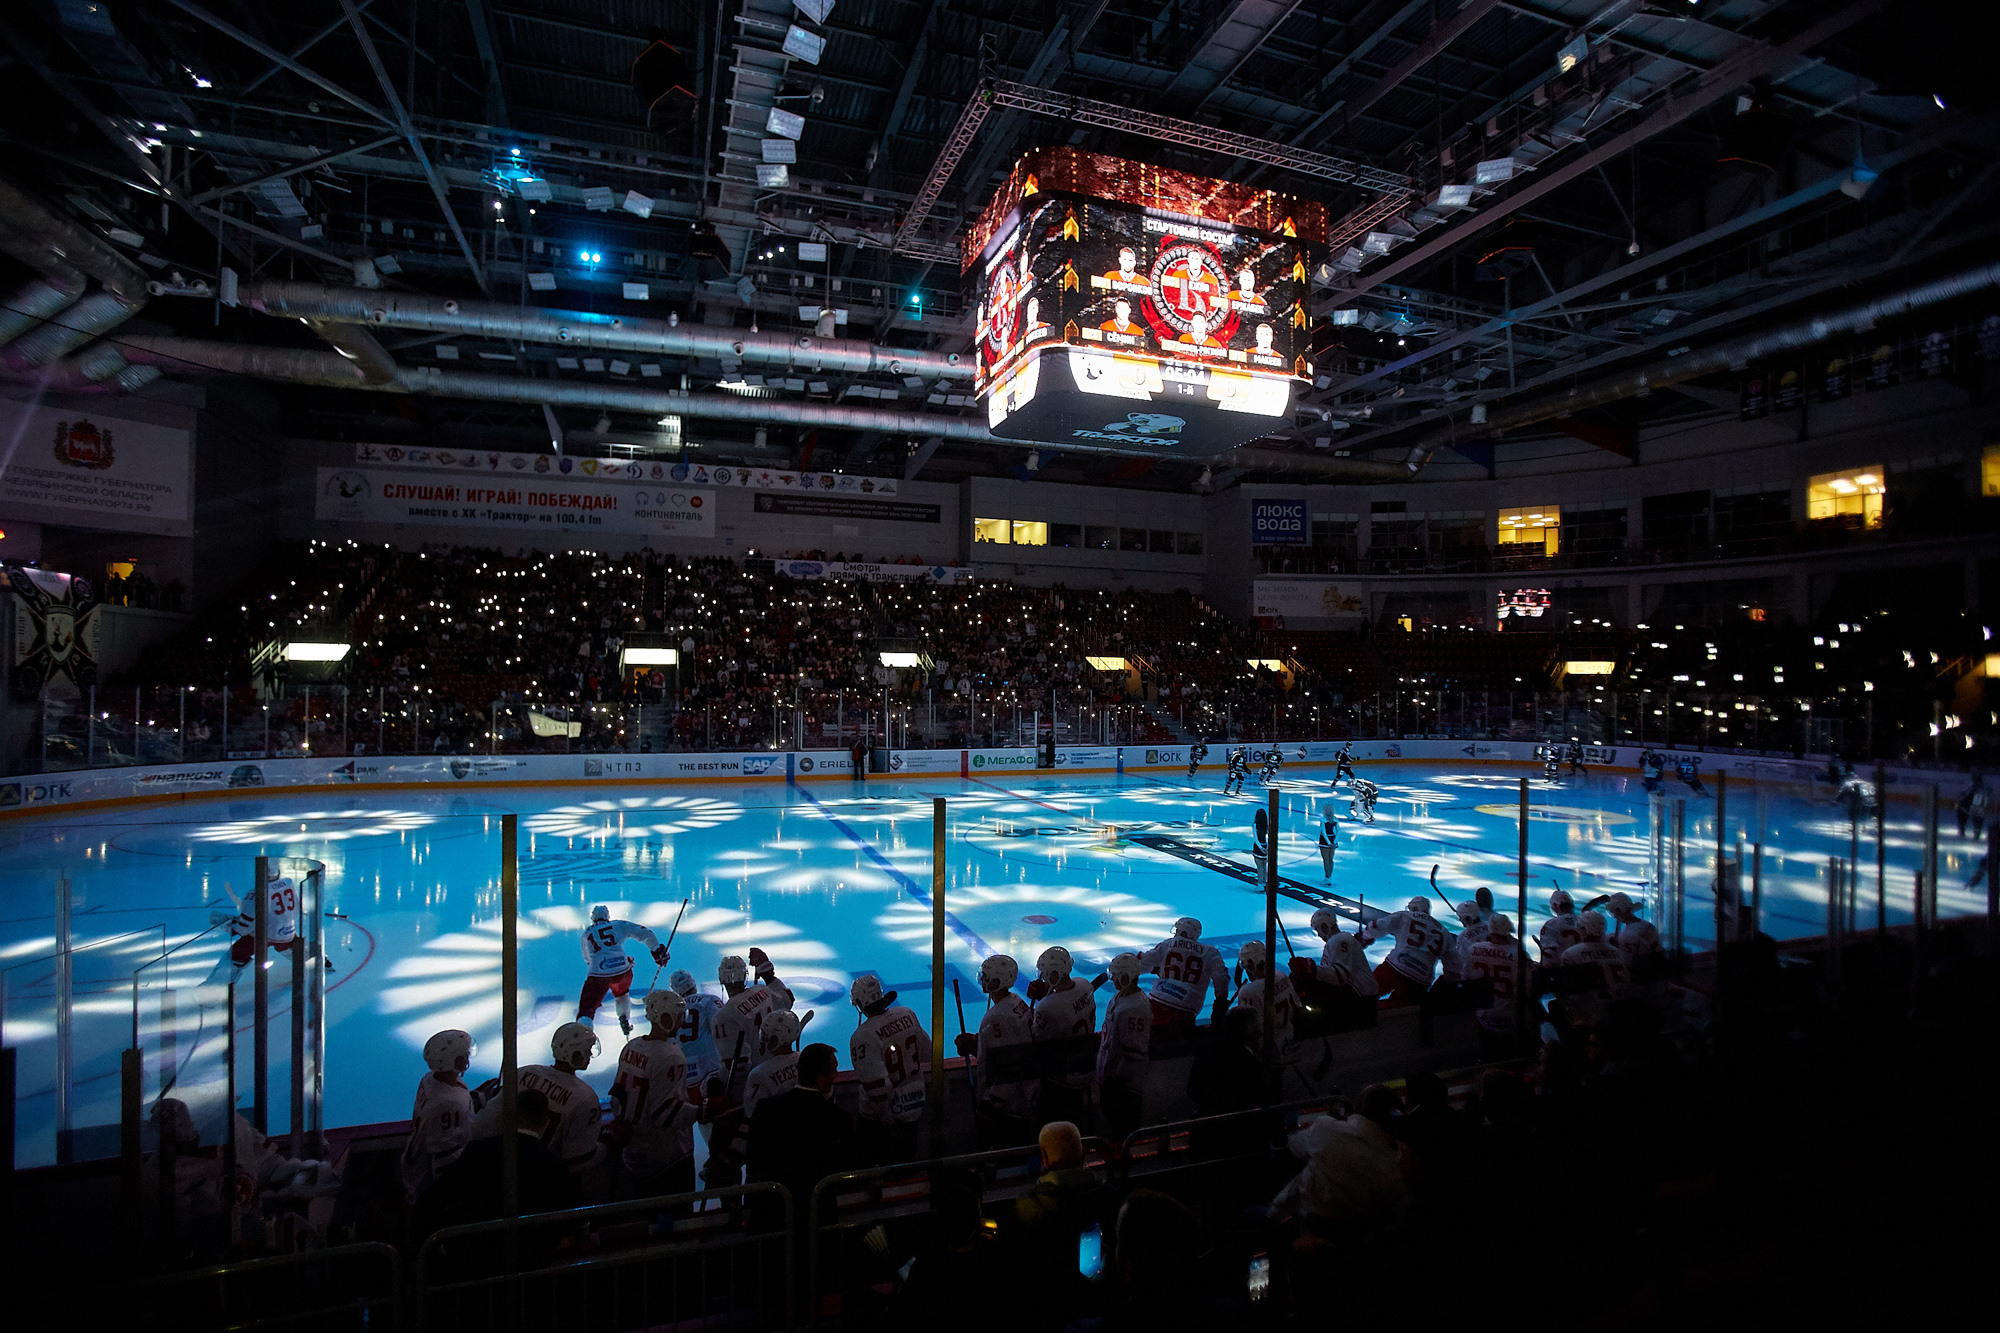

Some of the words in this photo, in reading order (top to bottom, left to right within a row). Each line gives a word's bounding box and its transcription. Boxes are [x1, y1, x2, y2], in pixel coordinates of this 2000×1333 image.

[1200, 229, 1234, 246] СОСТАВ
[94, 477, 172, 494] ГУБЕРНАТОРА
[100, 487, 154, 502] ОБЛАСТИ
[383, 483, 460, 502] СЛУШАЙ!
[466, 487, 522, 506] ИГРАЙ!
[528, 491, 618, 511] ПОБЕЖДАЙ!
[408, 507, 448, 518] вместе
[452, 510, 458, 518] с
[462, 508, 476, 519] ХК
[539, 514, 552, 523] на
[588, 514, 602, 526] fm
[1256, 504, 1303, 519] ЛЮКС
[842, 562, 881, 575] Смотри
[743, 758, 773, 773] SAP
[1159, 752, 1182, 763] ЮГК
[356, 766, 379, 776] РМК
[678, 762, 695, 772] THE
[696, 762, 719, 772] BEST
[720, 762, 739, 772] RUN
[24, 782, 73, 803] ЮГК
[271, 888, 295, 916] 33
[588, 925, 618, 954] 15
[1406, 920, 1444, 956] 53
[1164, 951, 1204, 986] 68
[993, 1024, 1002, 1039] 5
[1127, 1016, 1145, 1033] 55
[884, 1033, 922, 1090] 93
[752, 1083, 761, 1100] 7
[441, 1111, 461, 1131] 91
